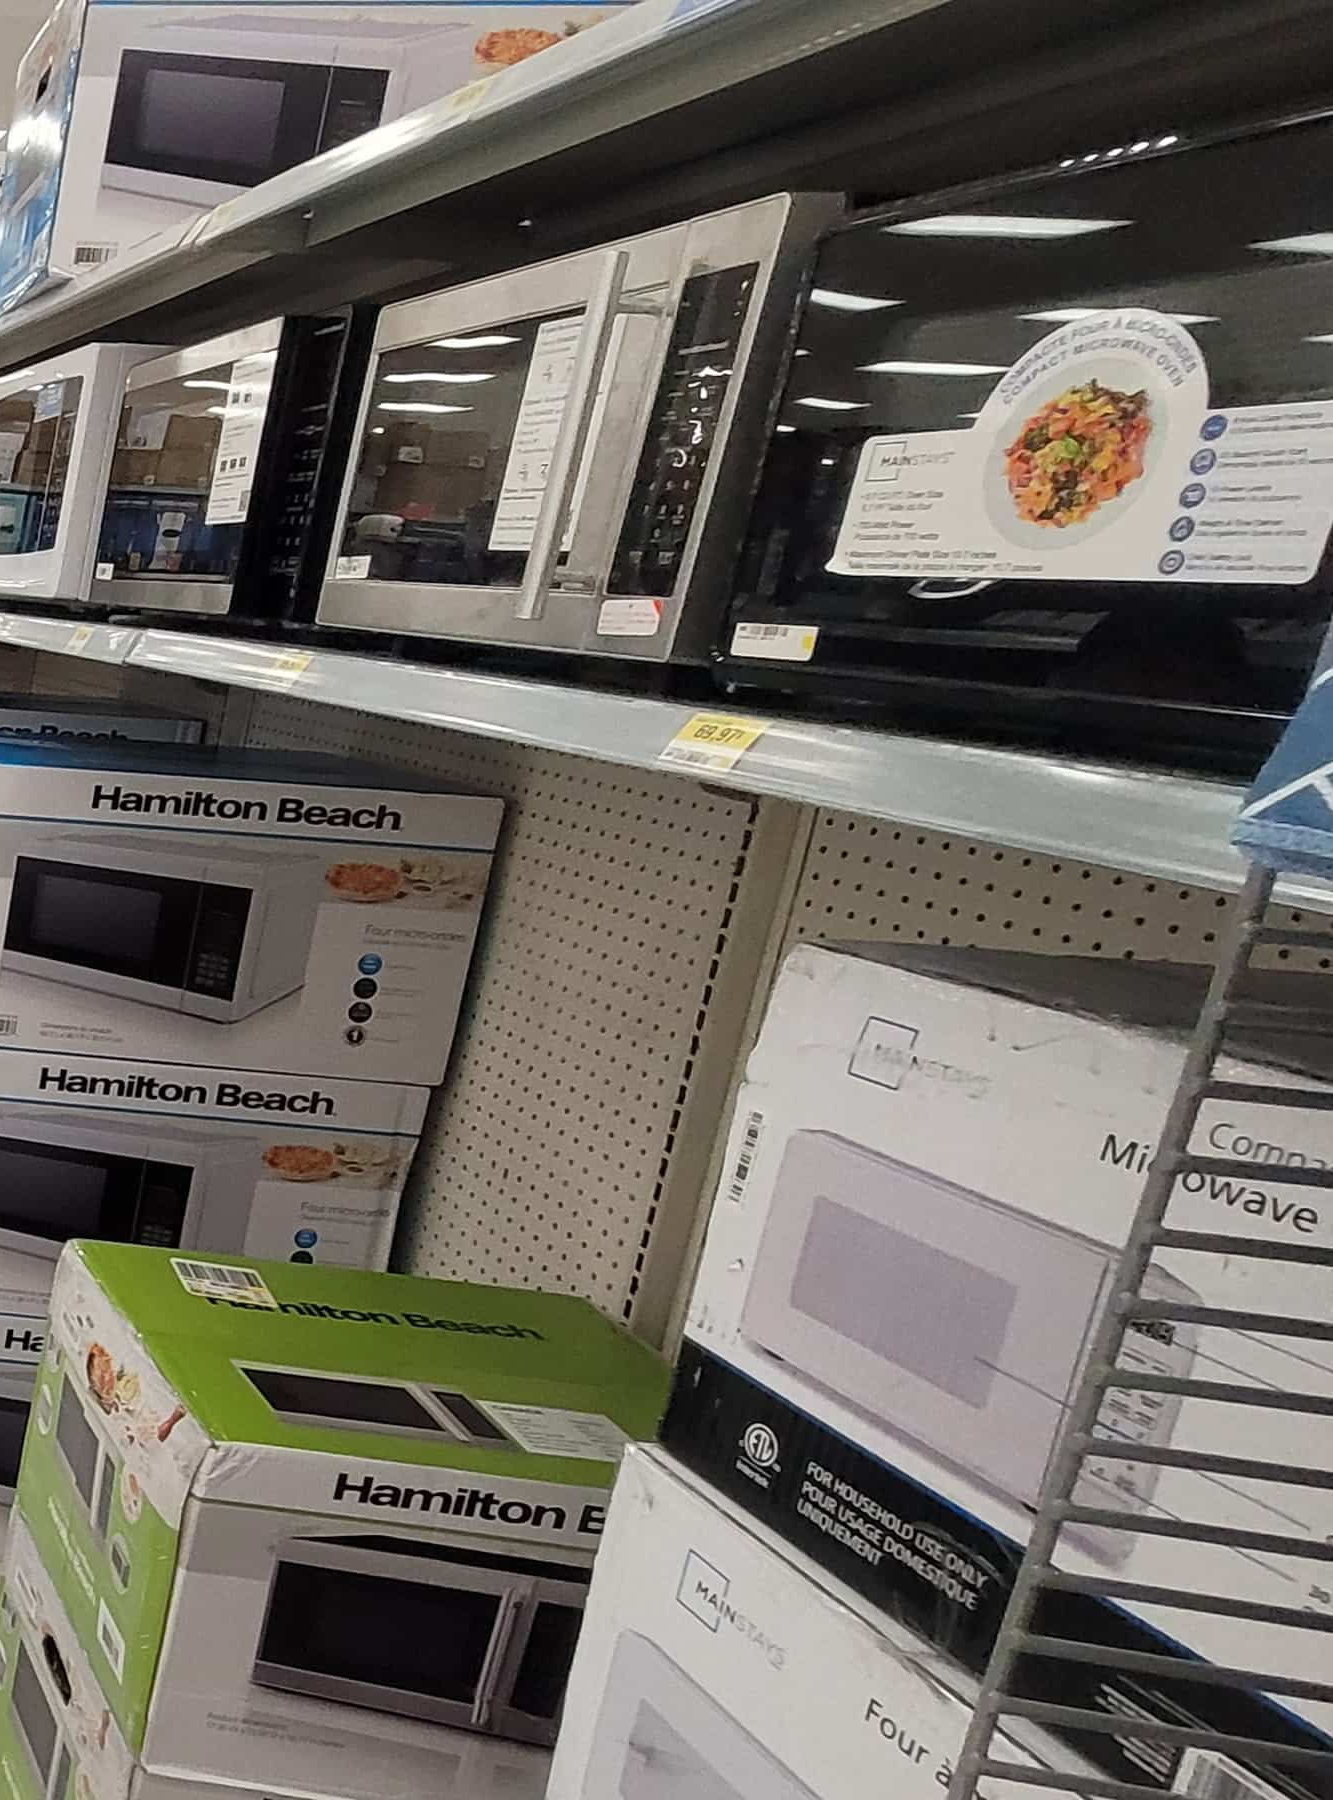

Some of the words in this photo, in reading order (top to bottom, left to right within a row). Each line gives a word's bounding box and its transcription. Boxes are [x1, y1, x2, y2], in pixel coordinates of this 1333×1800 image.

[1156, 353, 1185, 388] OVEN
[90, 785, 268, 822] Hamilton
[275, 797, 402, 832] Beach
[38, 1066, 208, 1105] Hamilton
[215, 1083, 336, 1117] Beach
[1100, 1133, 1319, 1233] Miowave
[401, 1313, 546, 1342] Beach
[332, 1472, 567, 1528] Hamilton
[796, 1497, 885, 1567] UNIQUEMENT
[806, 1460, 834, 1486] FOR
[833, 1474, 915, 1541] HOUSEHOLD
[913, 1531, 944, 1562] USE
[941, 1548, 989, 1589] ONLY
[801, 1480, 838, 1514] POUR
[837, 1503, 886, 1548] USAGE
[883, 1536, 979, 1612] DOMESTIQUE
[694, 1579, 787, 1672] MAINSTAYS
[864, 1697, 931, 1766] Four
